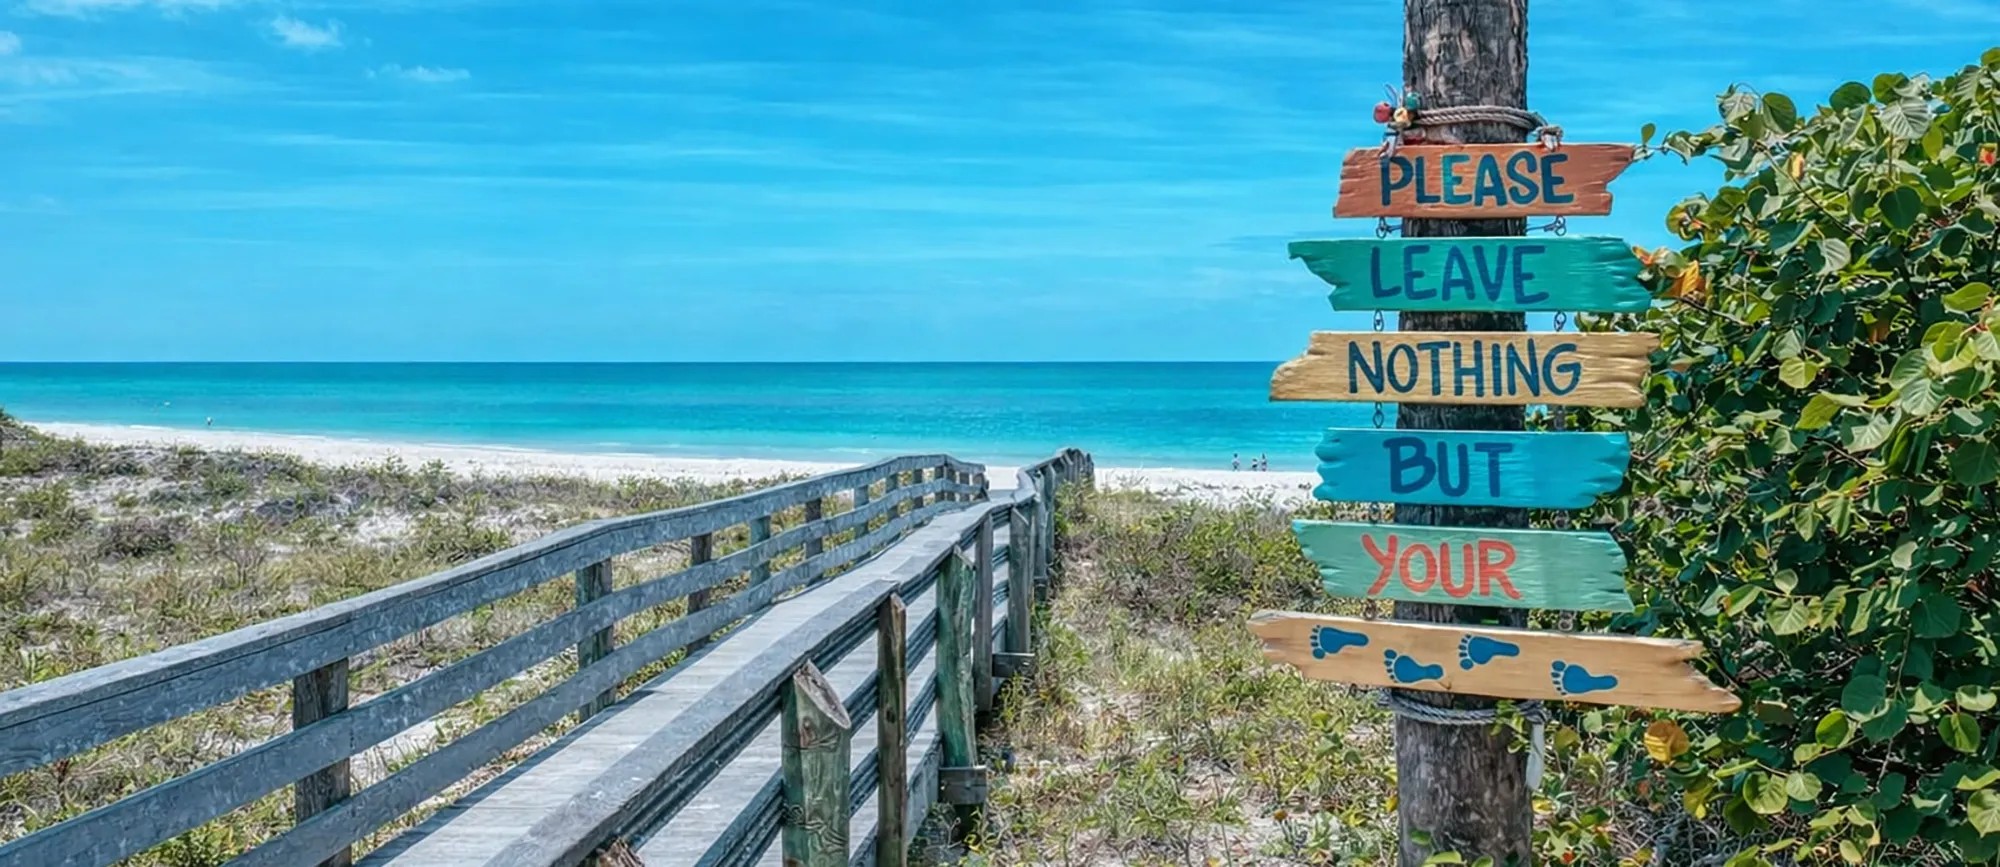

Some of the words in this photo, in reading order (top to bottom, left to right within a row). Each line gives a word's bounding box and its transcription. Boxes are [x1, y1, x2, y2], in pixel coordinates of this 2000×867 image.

[1380, 151, 1574, 207] PLEASE
[1371, 245, 1549, 304] LEAVE
[1348, 339, 1581, 397] NOTHING
[1383, 436, 1512, 498] BUT
[1361, 533, 1521, 599] YOUR
